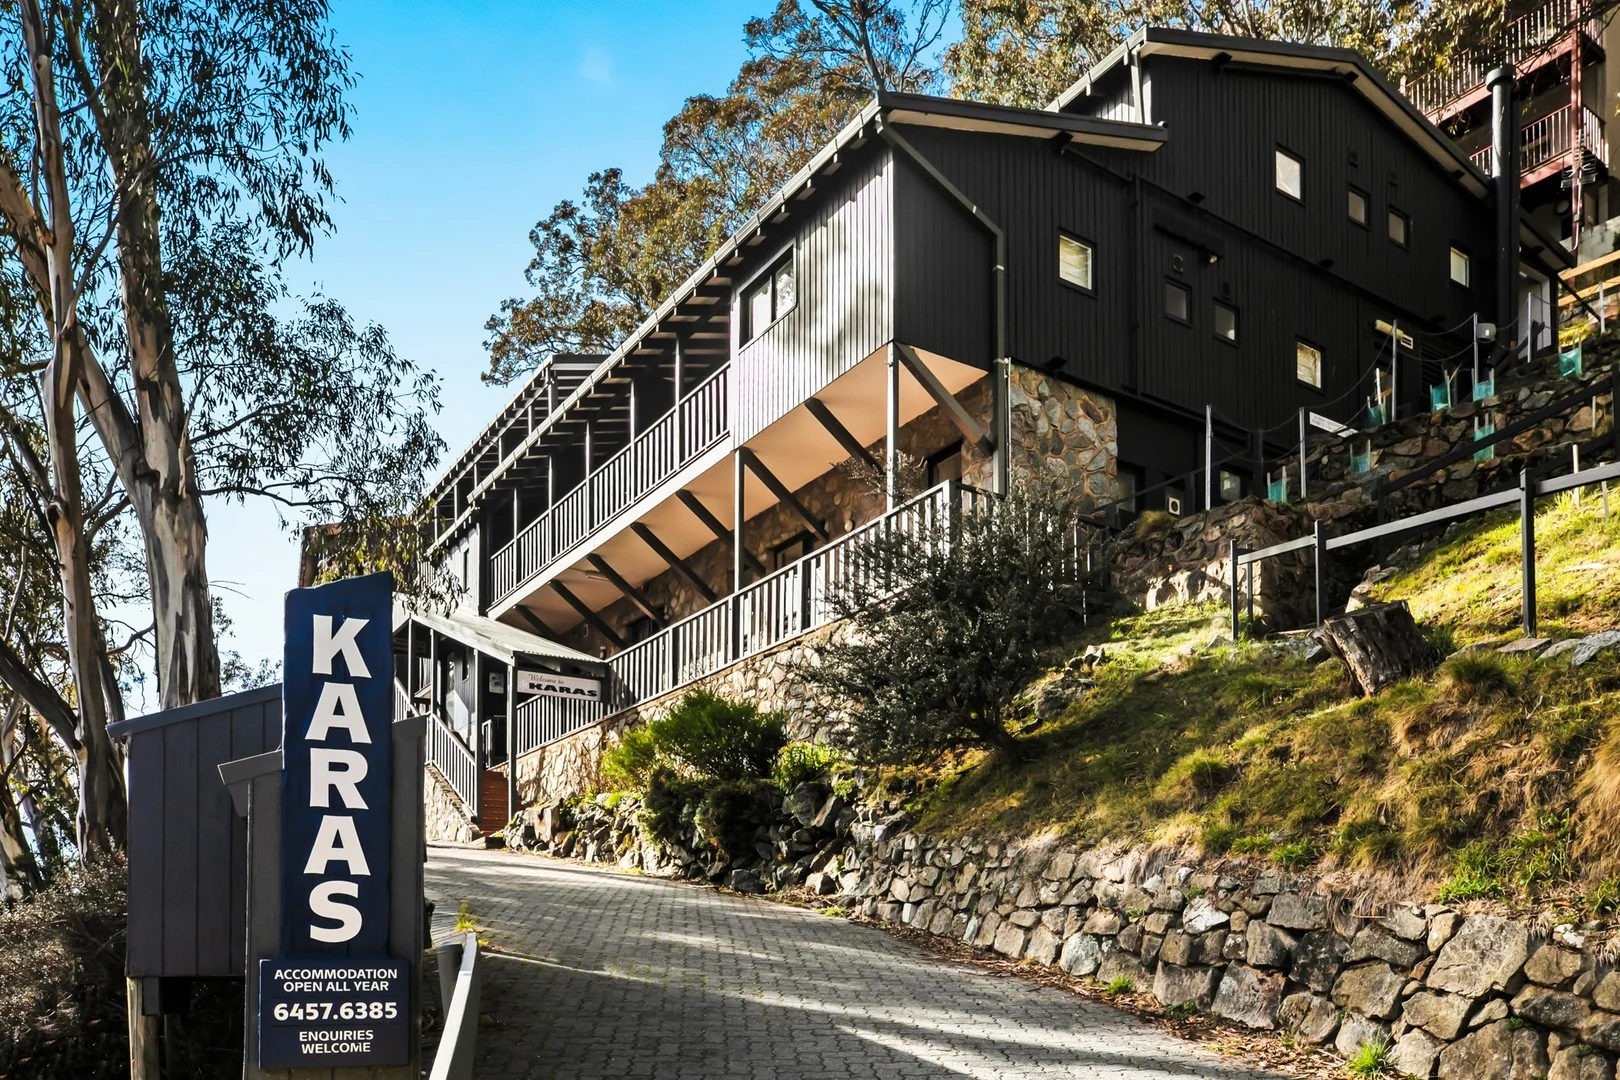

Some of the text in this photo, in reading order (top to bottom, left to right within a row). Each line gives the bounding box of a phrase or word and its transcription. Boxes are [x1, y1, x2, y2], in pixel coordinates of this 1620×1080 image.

[528, 673, 557, 684] Welcome
[528, 682, 598, 697] KARAS
[304, 614, 372, 943] KARAS
[274, 969, 398, 980] ACCOMMODATION
[283, 981, 389, 993] OPEN ALL YEAR
[273, 1002, 398, 1021] 6457.6385
[299, 1030, 374, 1042] ENQUIRIES
[301, 1042, 371, 1054] WELCOME
